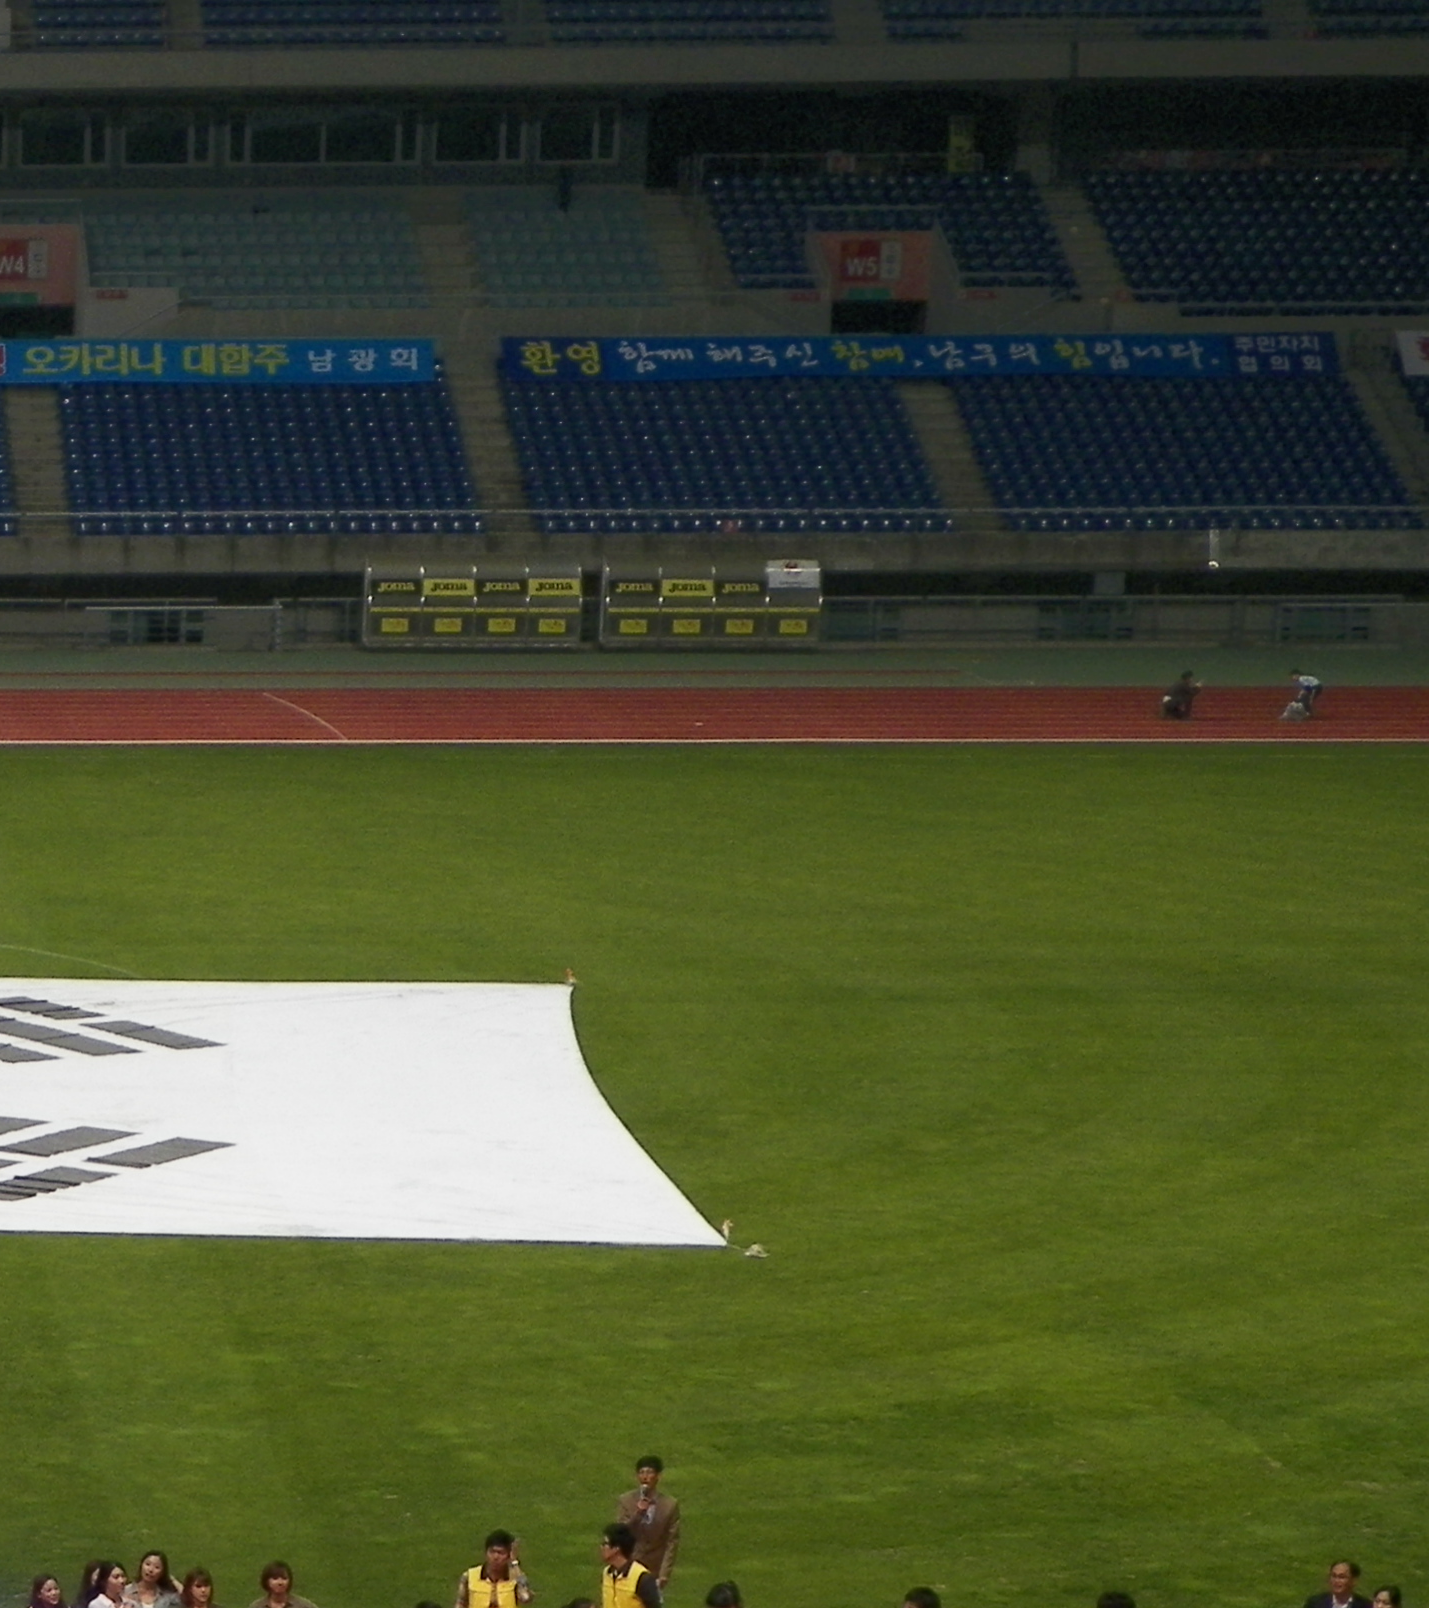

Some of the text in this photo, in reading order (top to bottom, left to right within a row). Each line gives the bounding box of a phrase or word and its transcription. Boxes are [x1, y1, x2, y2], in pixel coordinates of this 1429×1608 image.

[846, 256, 878, 277] W5
[22, 342, 166, 376] 오카리나
[181, 342, 290, 376] 대합주
[519, 340, 602, 376] 환영
[618, 340, 695, 374] 함께
[927, 339, 1041, 371] 남구의
